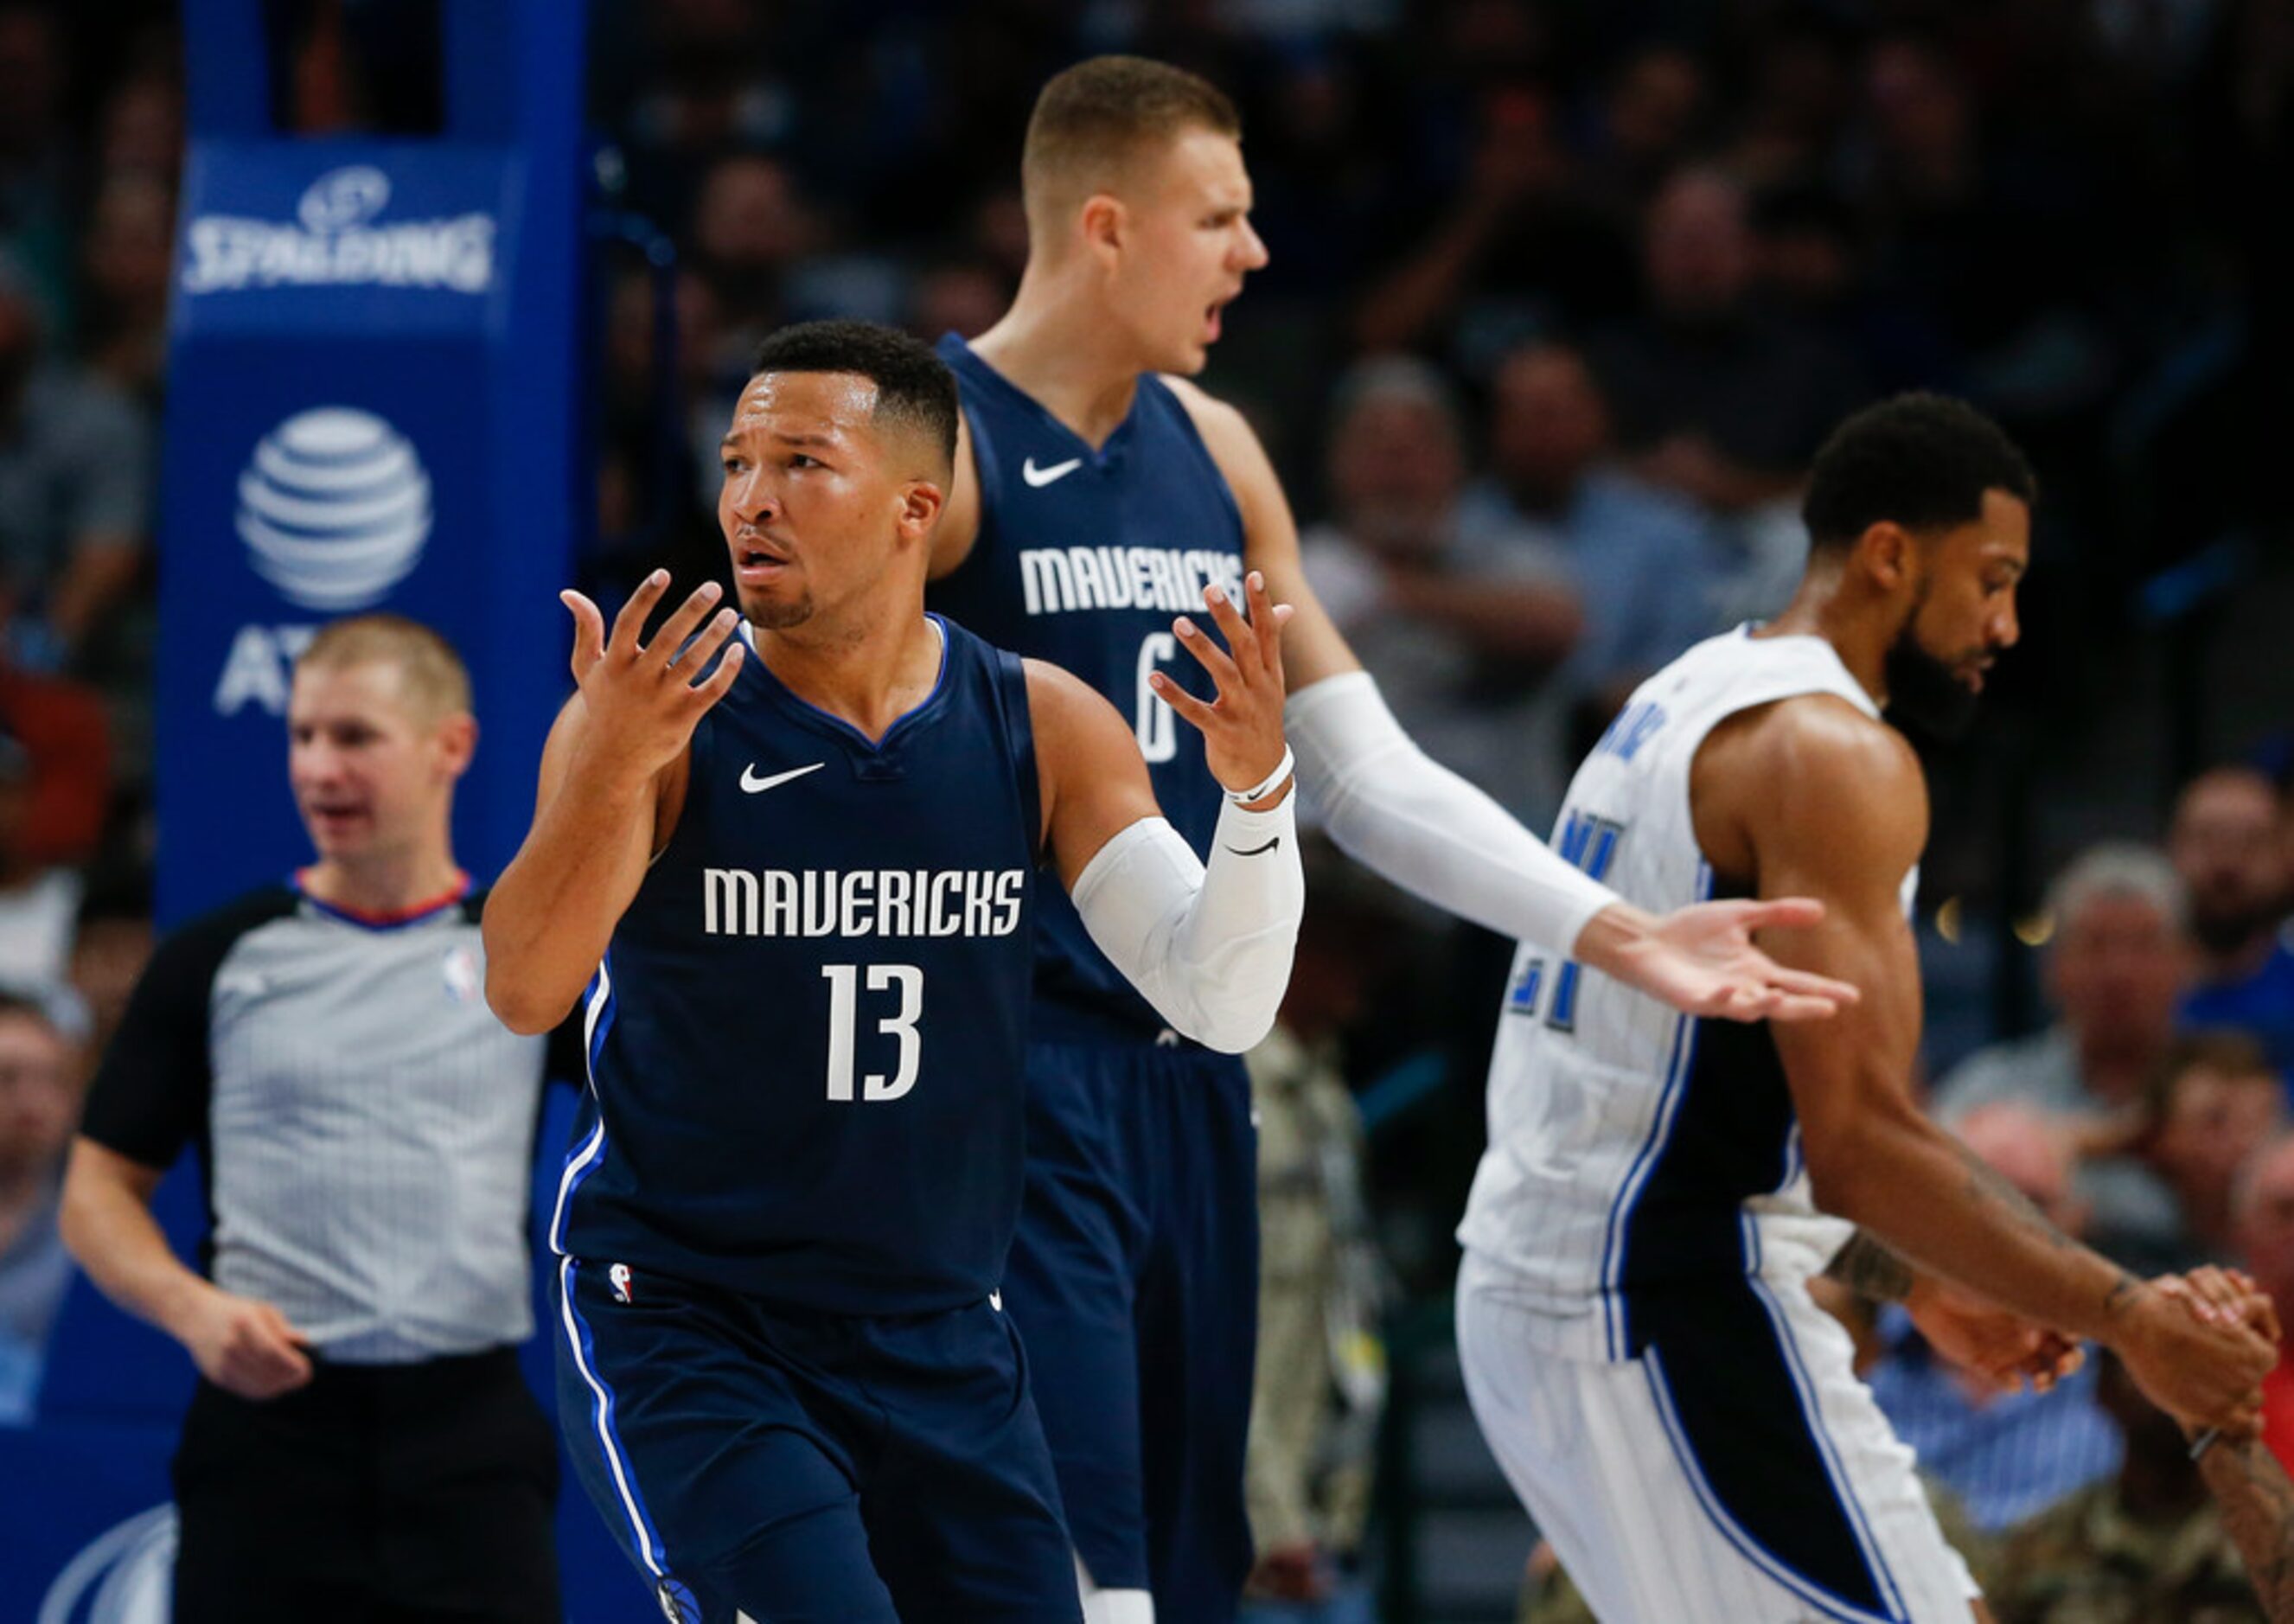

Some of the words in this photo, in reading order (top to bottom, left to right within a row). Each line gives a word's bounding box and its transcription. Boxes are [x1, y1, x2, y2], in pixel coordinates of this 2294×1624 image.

[182, 215, 496, 293] SPALDING
[1135, 631, 1177, 763] 6
[704, 868, 1025, 937] MAVERICKS
[821, 964, 924, 1101] 13
